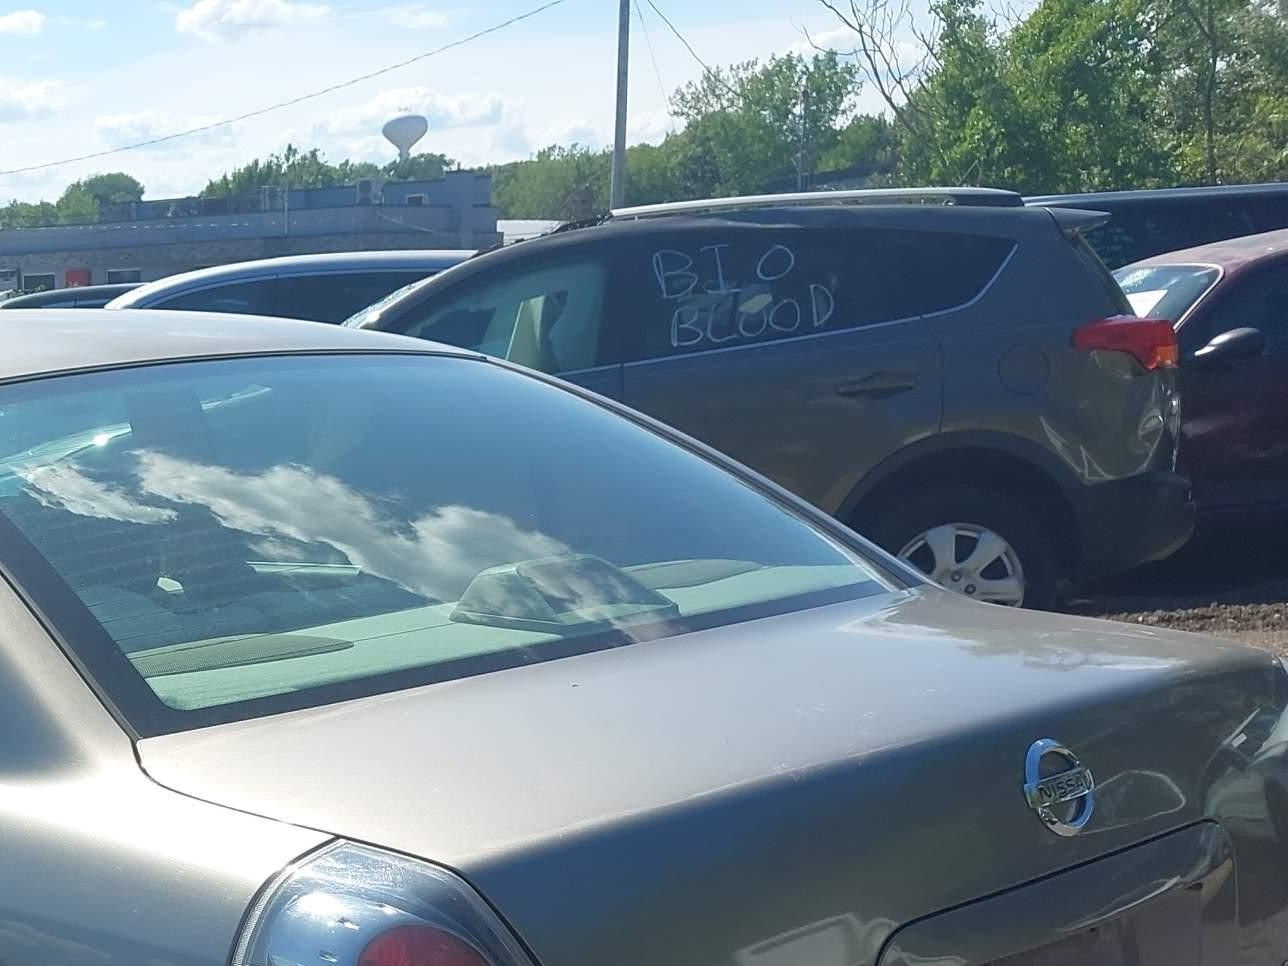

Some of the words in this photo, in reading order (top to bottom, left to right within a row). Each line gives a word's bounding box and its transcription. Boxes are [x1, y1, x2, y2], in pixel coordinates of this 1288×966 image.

[652, 243, 795, 299] BIO
[670, 283, 834, 347] BLOOD
[1037, 770, 1093, 801] NISSAN
